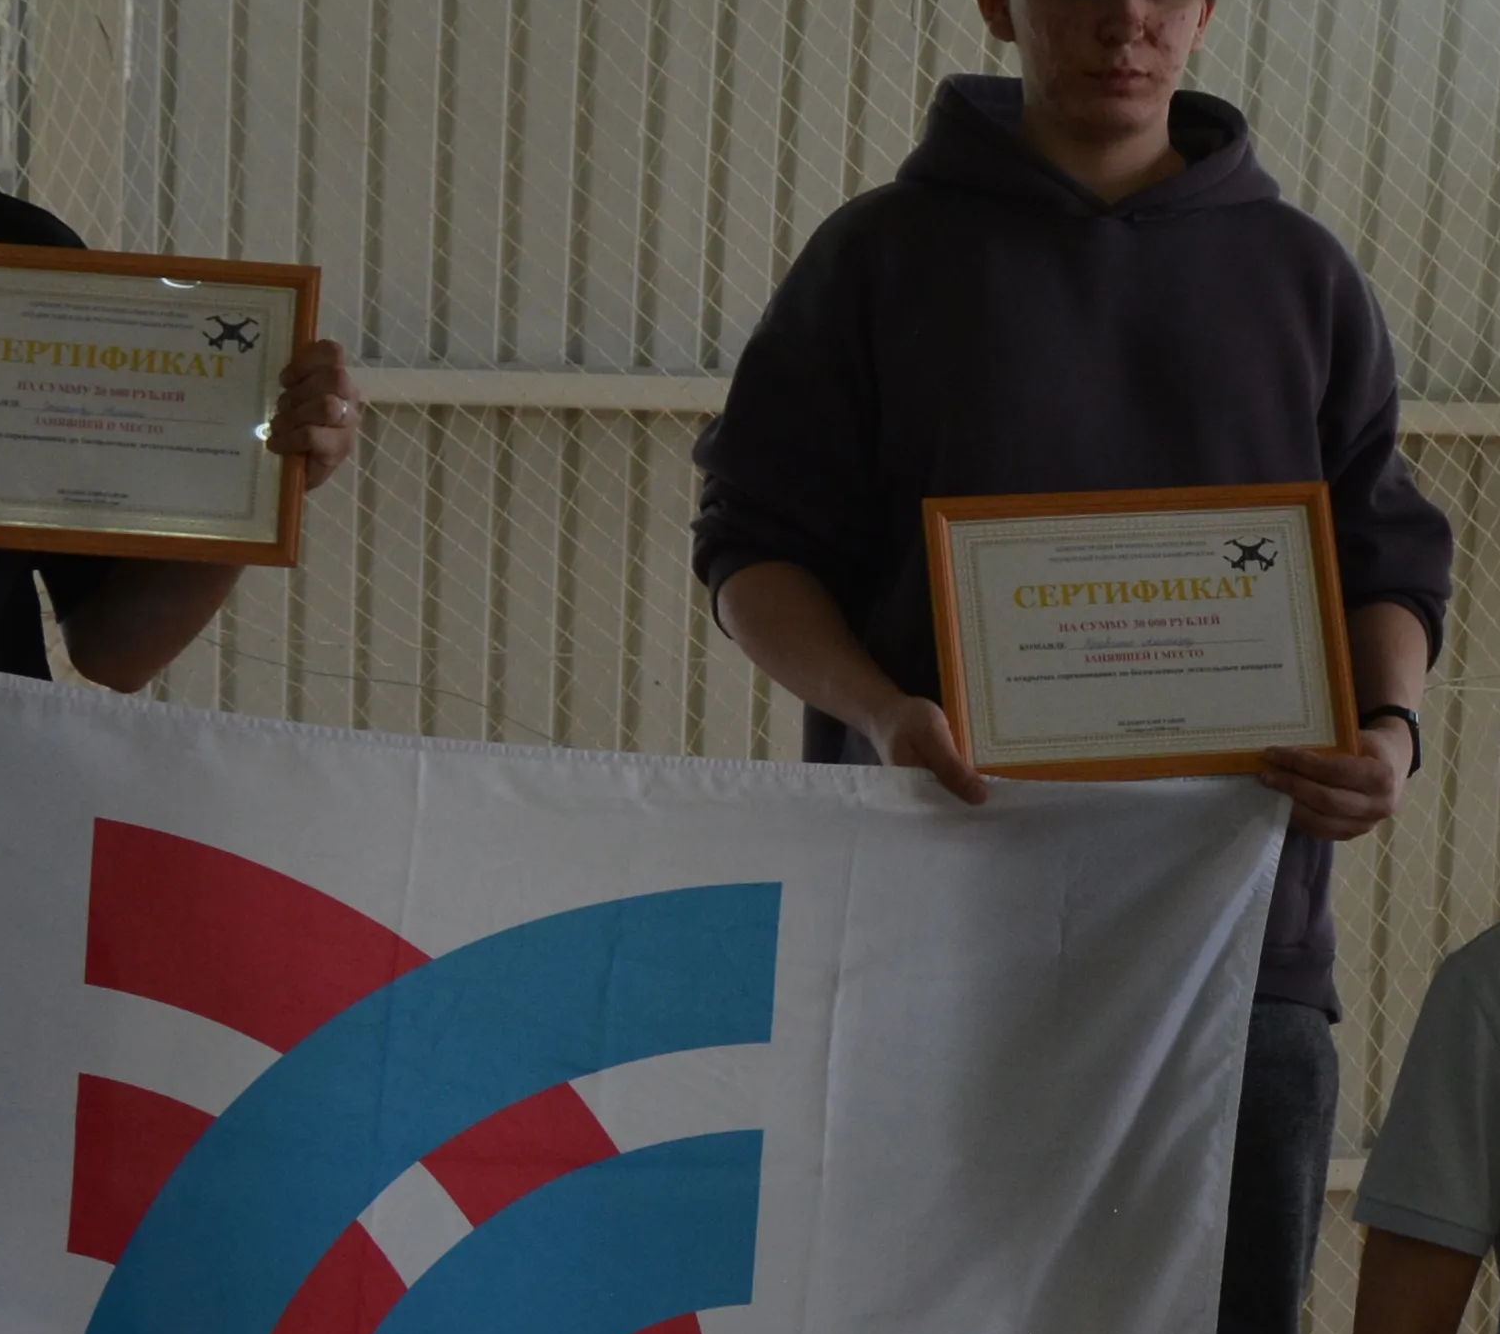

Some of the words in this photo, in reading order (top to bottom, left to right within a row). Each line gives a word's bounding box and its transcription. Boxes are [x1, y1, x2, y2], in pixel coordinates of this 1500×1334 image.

[38, 382, 91, 395] СУММУ
[131, 388, 186, 403] РУБЛЕЙ
[118, 422, 164, 435] МЕСТО
[1013, 574, 1259, 611] СЕРТИФИКАТ
[1058, 622, 1078, 634] НА
[1080, 619, 1128, 632] СУММУ
[1168, 613, 1221, 628] РУБЛЕЙ
[1160, 648, 1205, 661] МЕСТО
